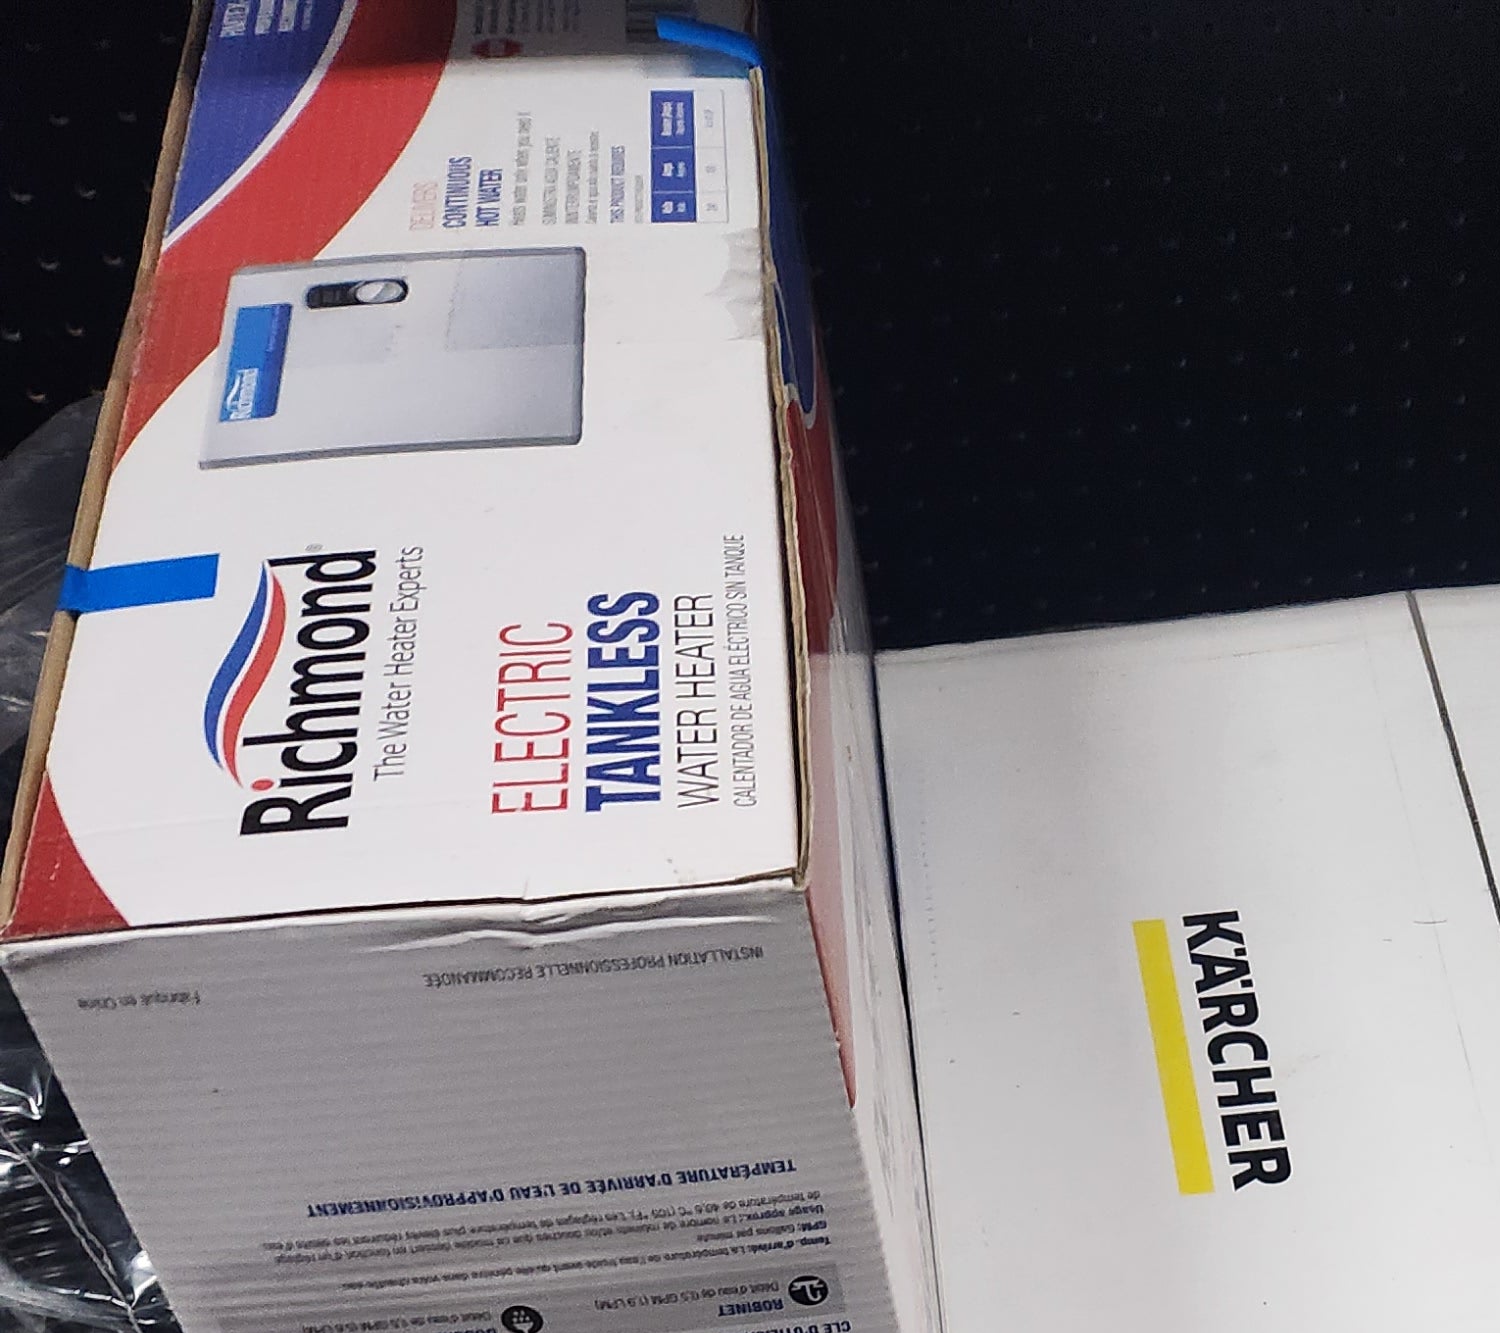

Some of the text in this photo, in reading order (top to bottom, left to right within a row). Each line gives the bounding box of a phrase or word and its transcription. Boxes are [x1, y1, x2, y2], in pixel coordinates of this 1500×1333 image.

[442, 156, 472, 228] CONTINUOUS
[476, 169, 503, 227] HOT WATER
[722, 534, 747, 578] TANQUE
[726, 581, 748, 600] SIN
[373, 546, 427, 782] The Water Heater Experts
[728, 668, 752, 701] AGUA
[239, 550, 378, 836] Richmond
[584, 591, 661, 812] TANKLESS
[672, 594, 720, 808] WATER HEATER
[730, 704, 754, 722] DE
[491, 622, 572, 815] ELECTRIC
[730, 724, 758, 807] CALENTADOR
[667, 946, 764, 968] INSTALLATION
[1182, 909, 1292, 1192] KÄRCHER
[509, 1181, 556, 1203] L'EAU
[559, 1181, 581, 1199] DE
[585, 1172, 672, 1198] D'ARRIVÉE
[675, 1158, 798, 1188] TEMPÉRATURE
[717, 1298, 784, 1318] ROBINET
